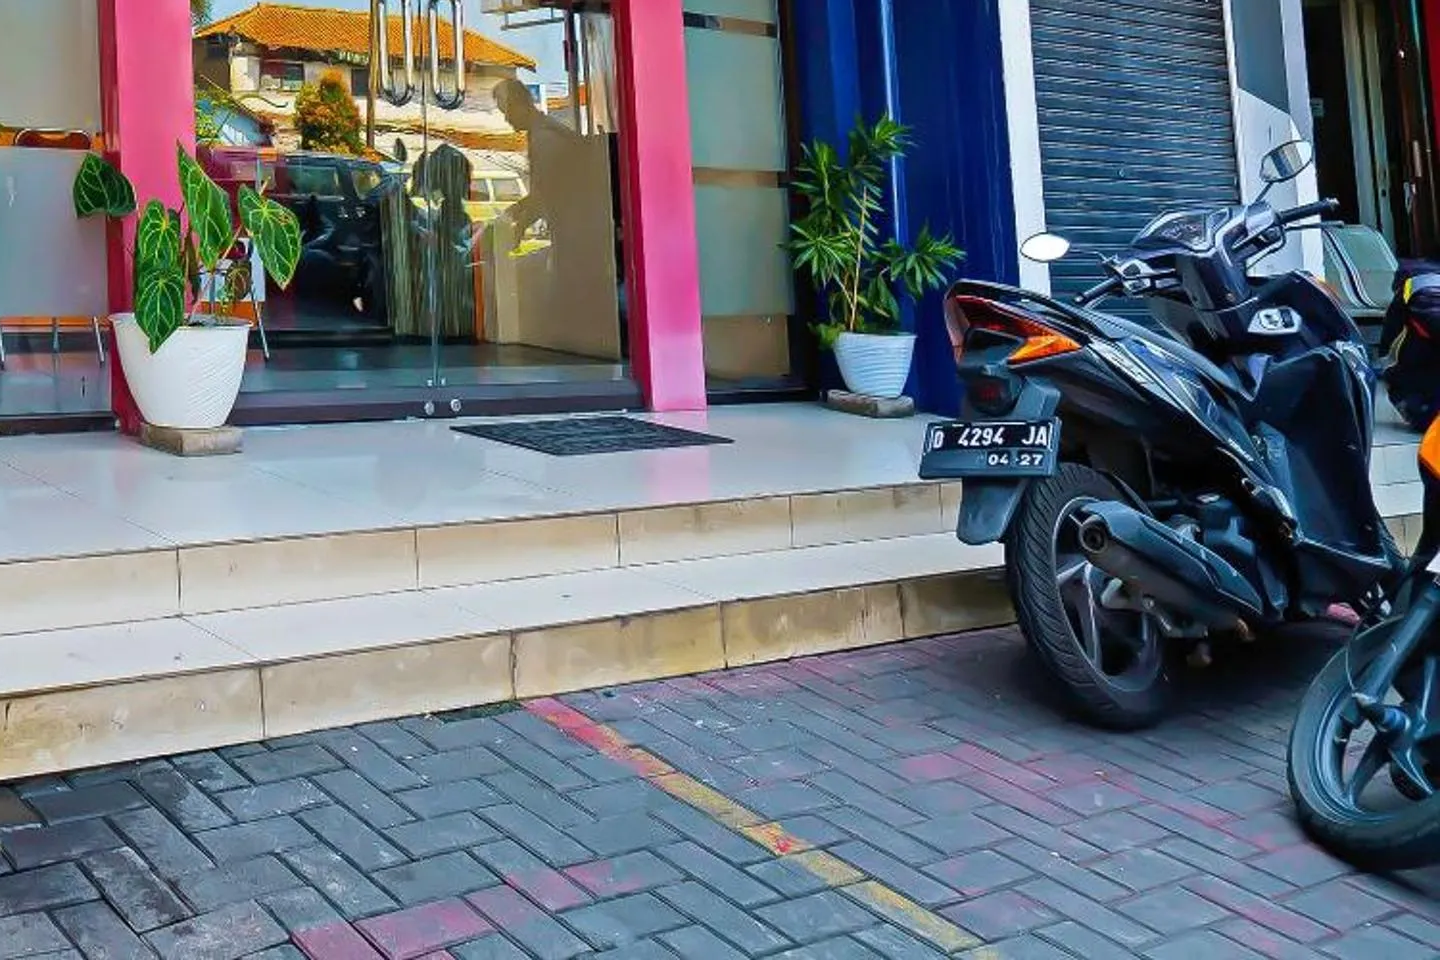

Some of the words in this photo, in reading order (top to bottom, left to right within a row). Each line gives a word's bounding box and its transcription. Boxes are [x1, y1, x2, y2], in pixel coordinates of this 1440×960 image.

[957, 426, 1006, 447] 4294
[1021, 425, 1048, 447] JA
[987, 453, 1010, 466] 04
